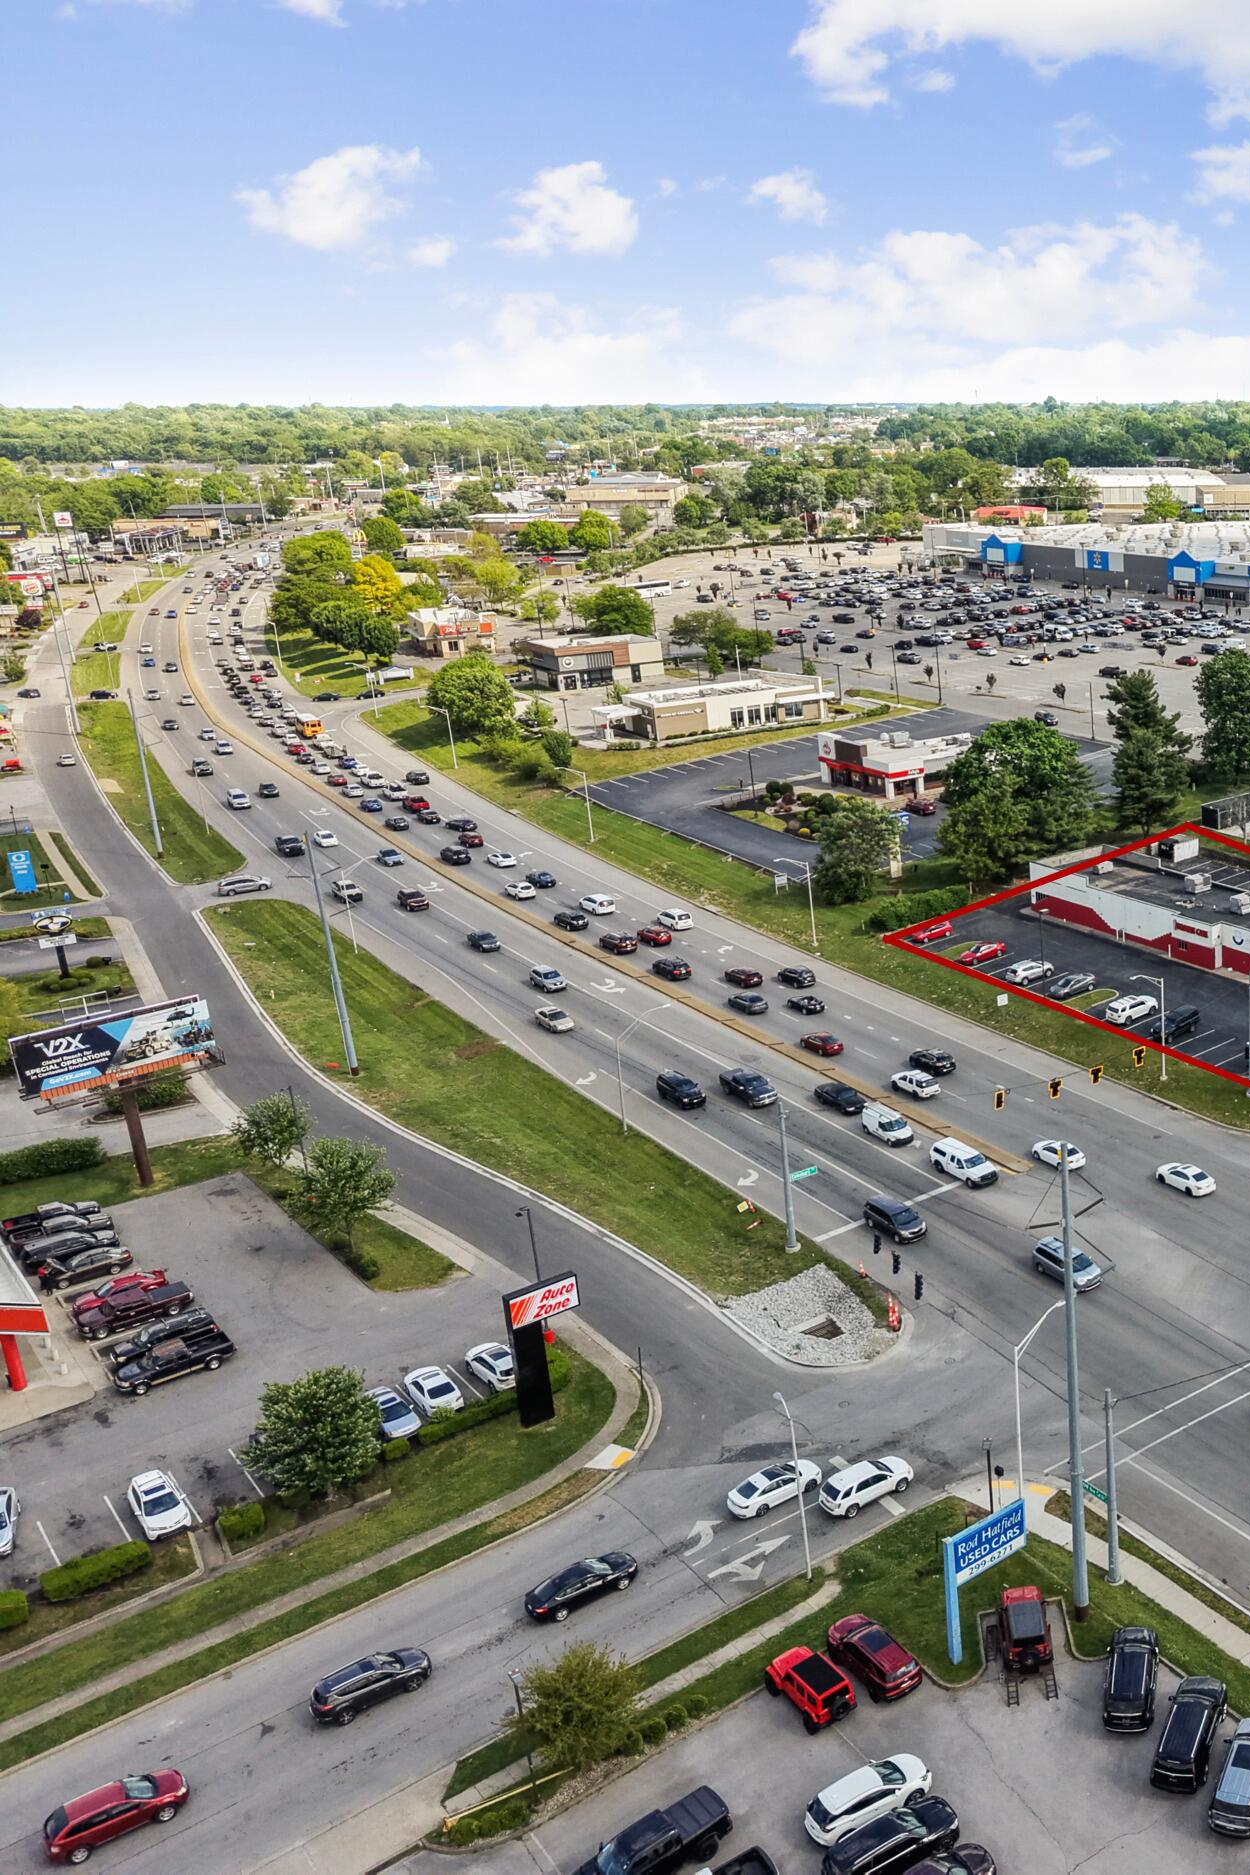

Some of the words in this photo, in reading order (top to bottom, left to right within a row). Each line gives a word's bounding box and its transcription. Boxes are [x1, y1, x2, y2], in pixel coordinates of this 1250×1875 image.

[33, 1033, 88, 1057] V2X
[25, 1063, 60, 1076] SPECIAL
[61, 1050, 111, 1067] OPERATIONS
[540, 1282, 574, 1303] Auto
[533, 1298, 570, 1319] Zone
[958, 1534, 978, 1556] Rod
[982, 1509, 1021, 1542] Hatfield
[960, 1544, 989, 1567] USED
[992, 1525, 1020, 1548] CARS
[968, 1543, 1013, 1576] 299-6271
